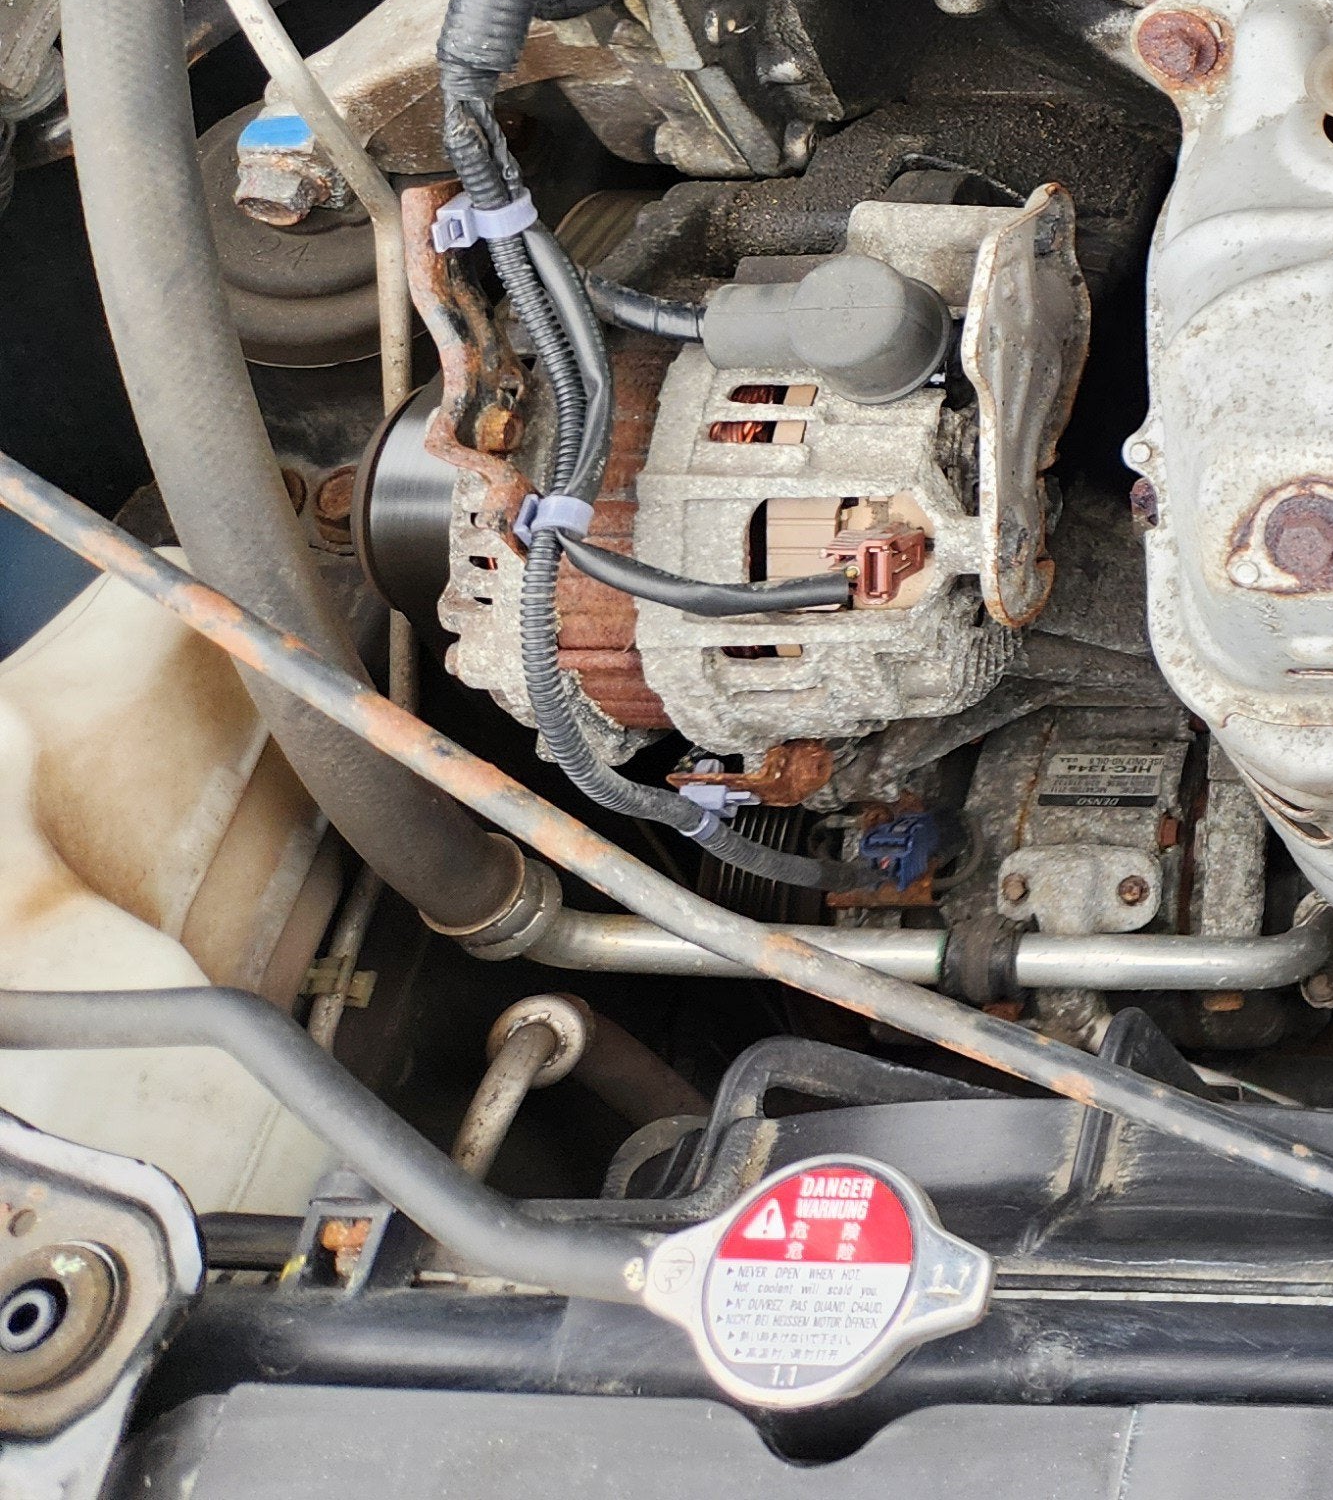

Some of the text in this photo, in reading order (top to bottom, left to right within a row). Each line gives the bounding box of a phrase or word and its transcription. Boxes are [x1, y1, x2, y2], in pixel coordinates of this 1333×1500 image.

[1067, 765, 1151, 773] HFC-134a
[1076, 797, 1120, 806] DENSO
[799, 1176, 875, 1199] DANGER
[796, 1199, 868, 1220] WARNUNG
[738, 1267, 767, 1278] NEVER
[775, 1267, 799, 1279] OPEN
[809, 1268, 833, 1280] WHEN
[733, 1281, 749, 1292] Hot
[758, 1282, 794, 1294] coolant
[802, 1283, 820, 1294] will
[827, 1284, 853, 1295] scald
[748, 1299, 783, 1311] OUVREZ
[790, 1300, 808, 1311] PAS
[814, 1301, 846, 1312] QUAND
[772, 1366, 798, 1386] 1.1
